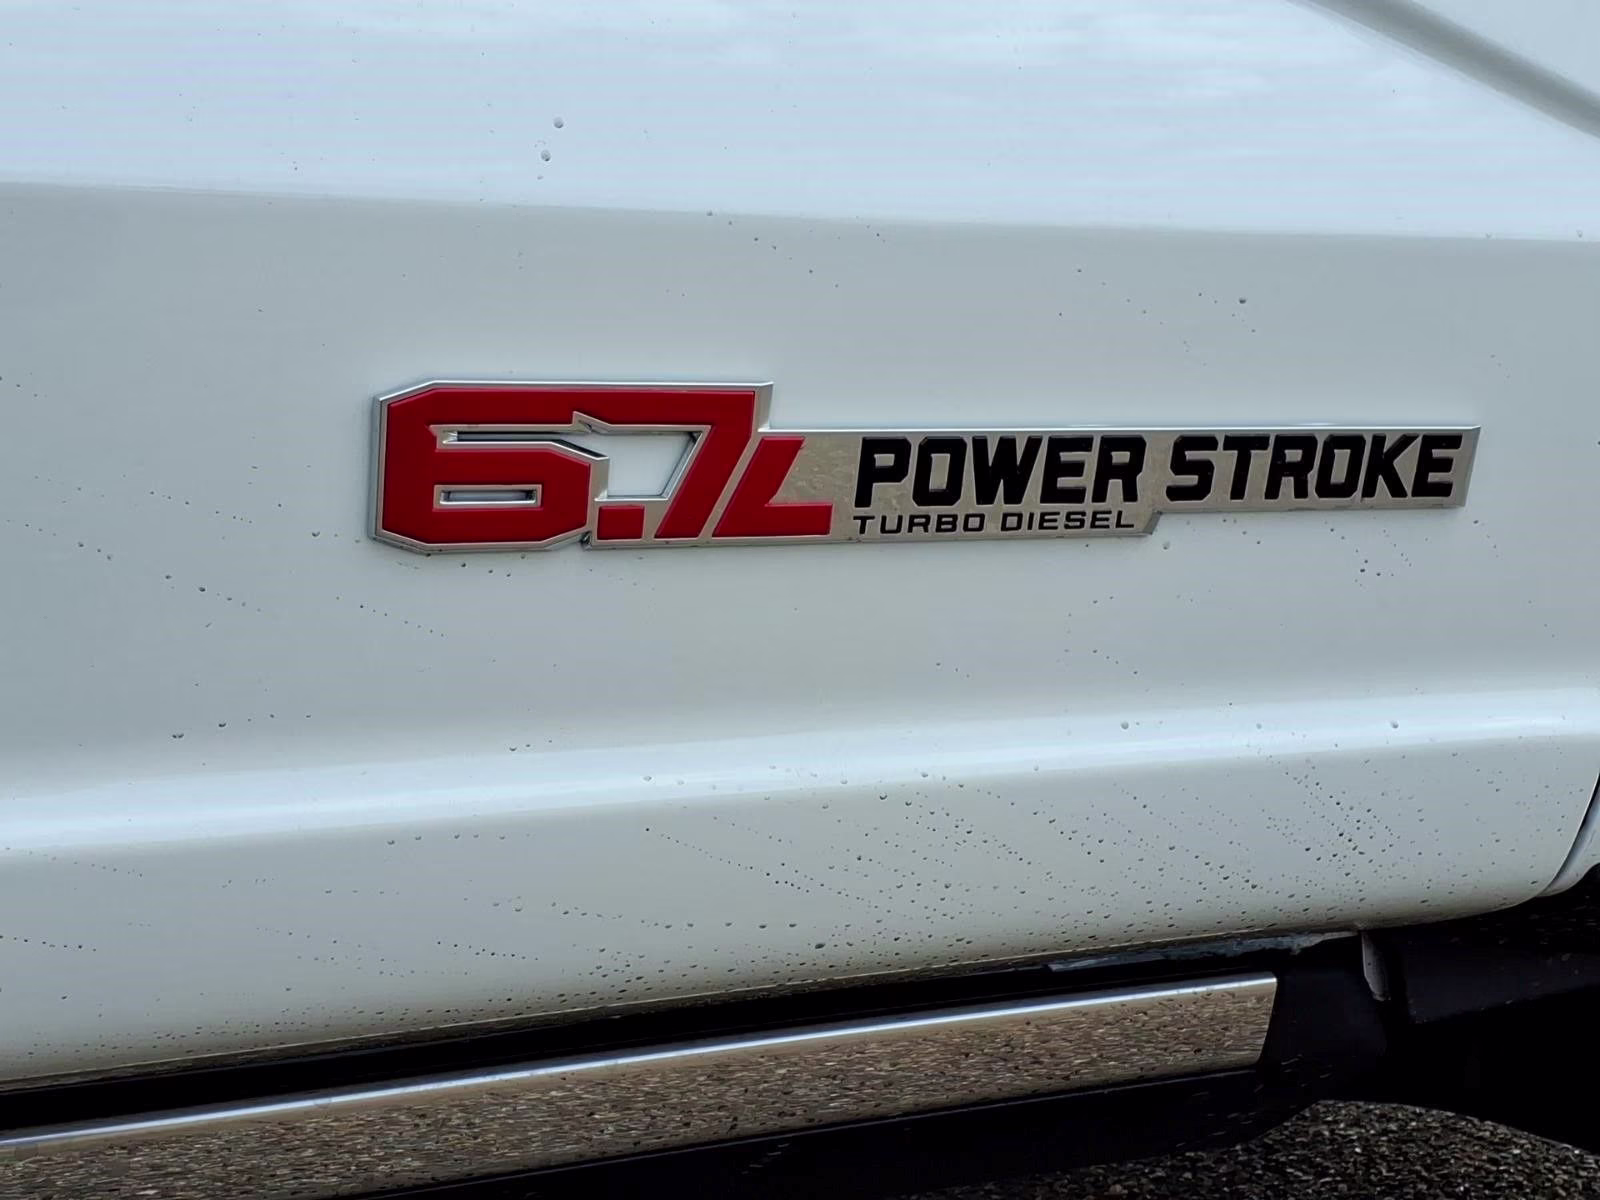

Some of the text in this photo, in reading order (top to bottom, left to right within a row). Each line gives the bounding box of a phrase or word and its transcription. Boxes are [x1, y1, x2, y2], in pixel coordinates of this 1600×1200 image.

[381, 388, 833, 545] 6.7L
[854, 434, 1463, 508] POWER STROKE
[853, 510, 1135, 535] TURBO DIESEL
